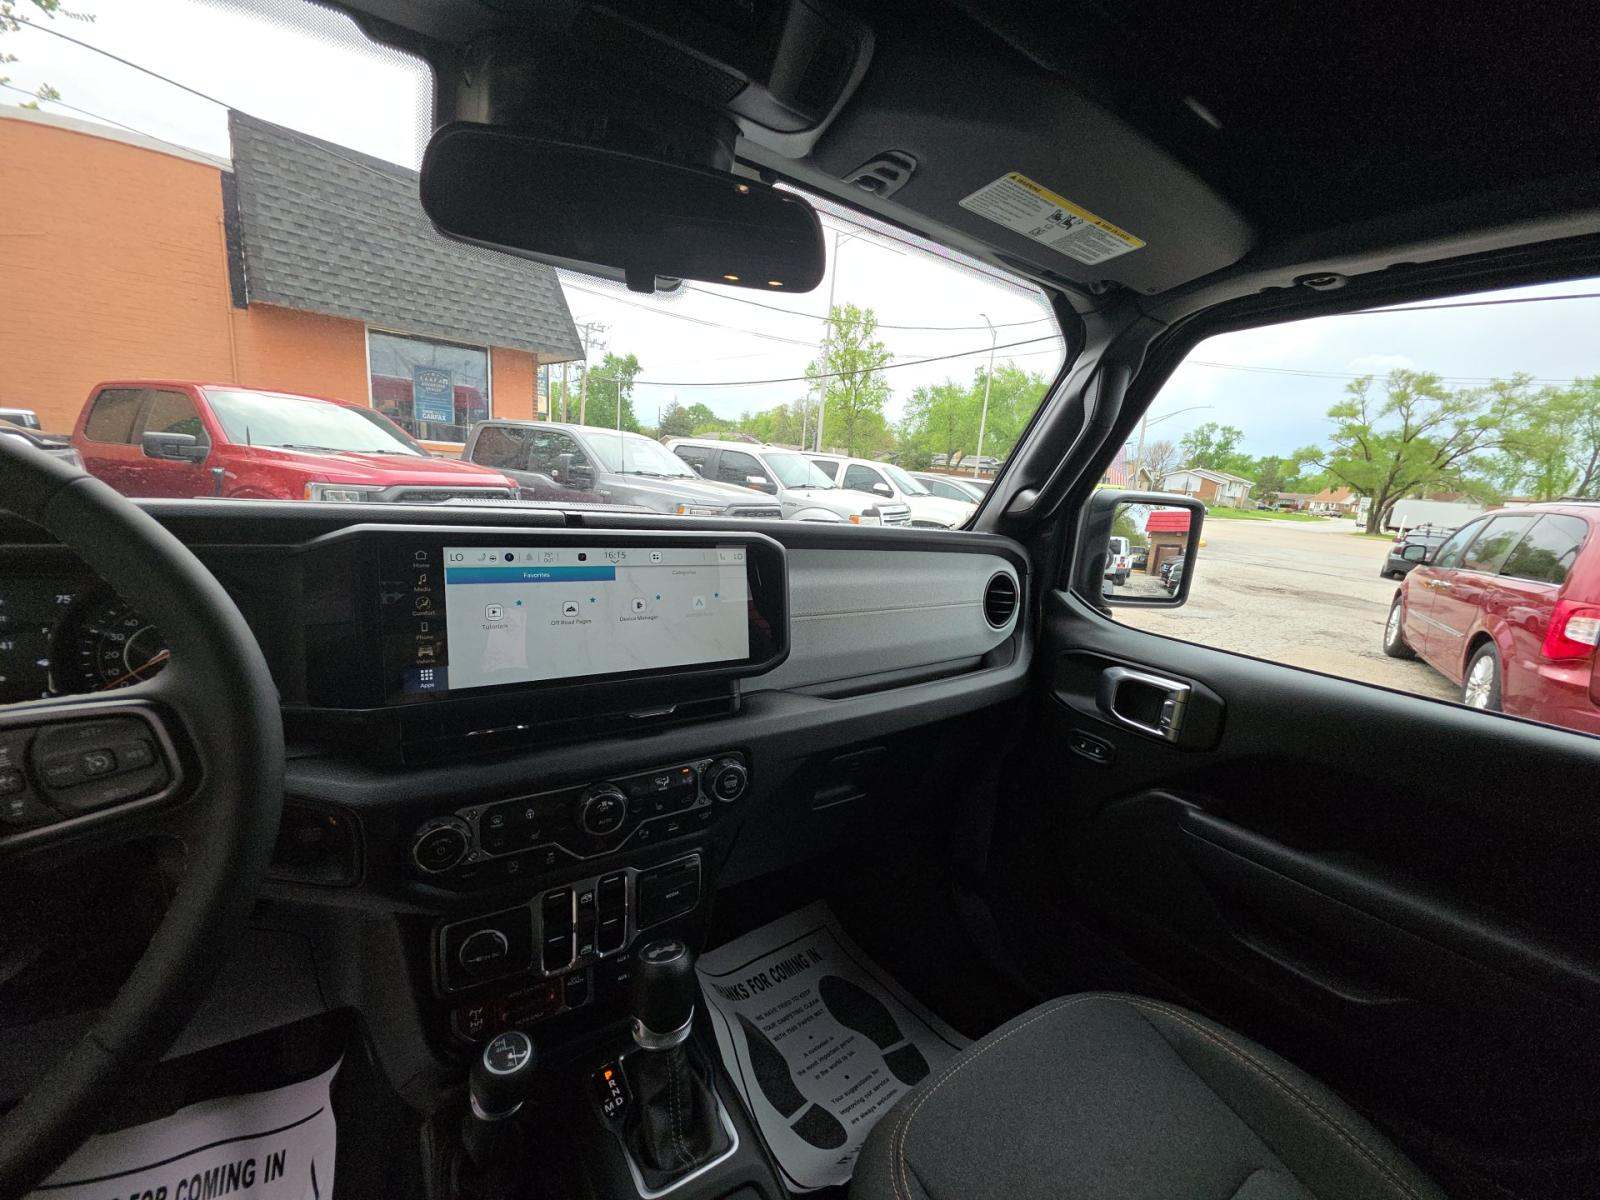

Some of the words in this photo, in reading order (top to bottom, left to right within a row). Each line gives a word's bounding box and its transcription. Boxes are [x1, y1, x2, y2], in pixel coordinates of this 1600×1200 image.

[422, 413, 447, 422] CARFAX
[450, 553, 464, 561] LO
[604, 551, 626, 559] 16:15
[746, 972, 774, 995] FOR
[768, 953, 811, 983] COMING
[806, 947, 823, 963] IN
[608, 1079, 616, 1088] R
[615, 1097, 623, 1105] D
[604, 1102, 614, 1112] M
[175, 1158, 257, 1200] COMING
[263, 1149, 287, 1184] IN
